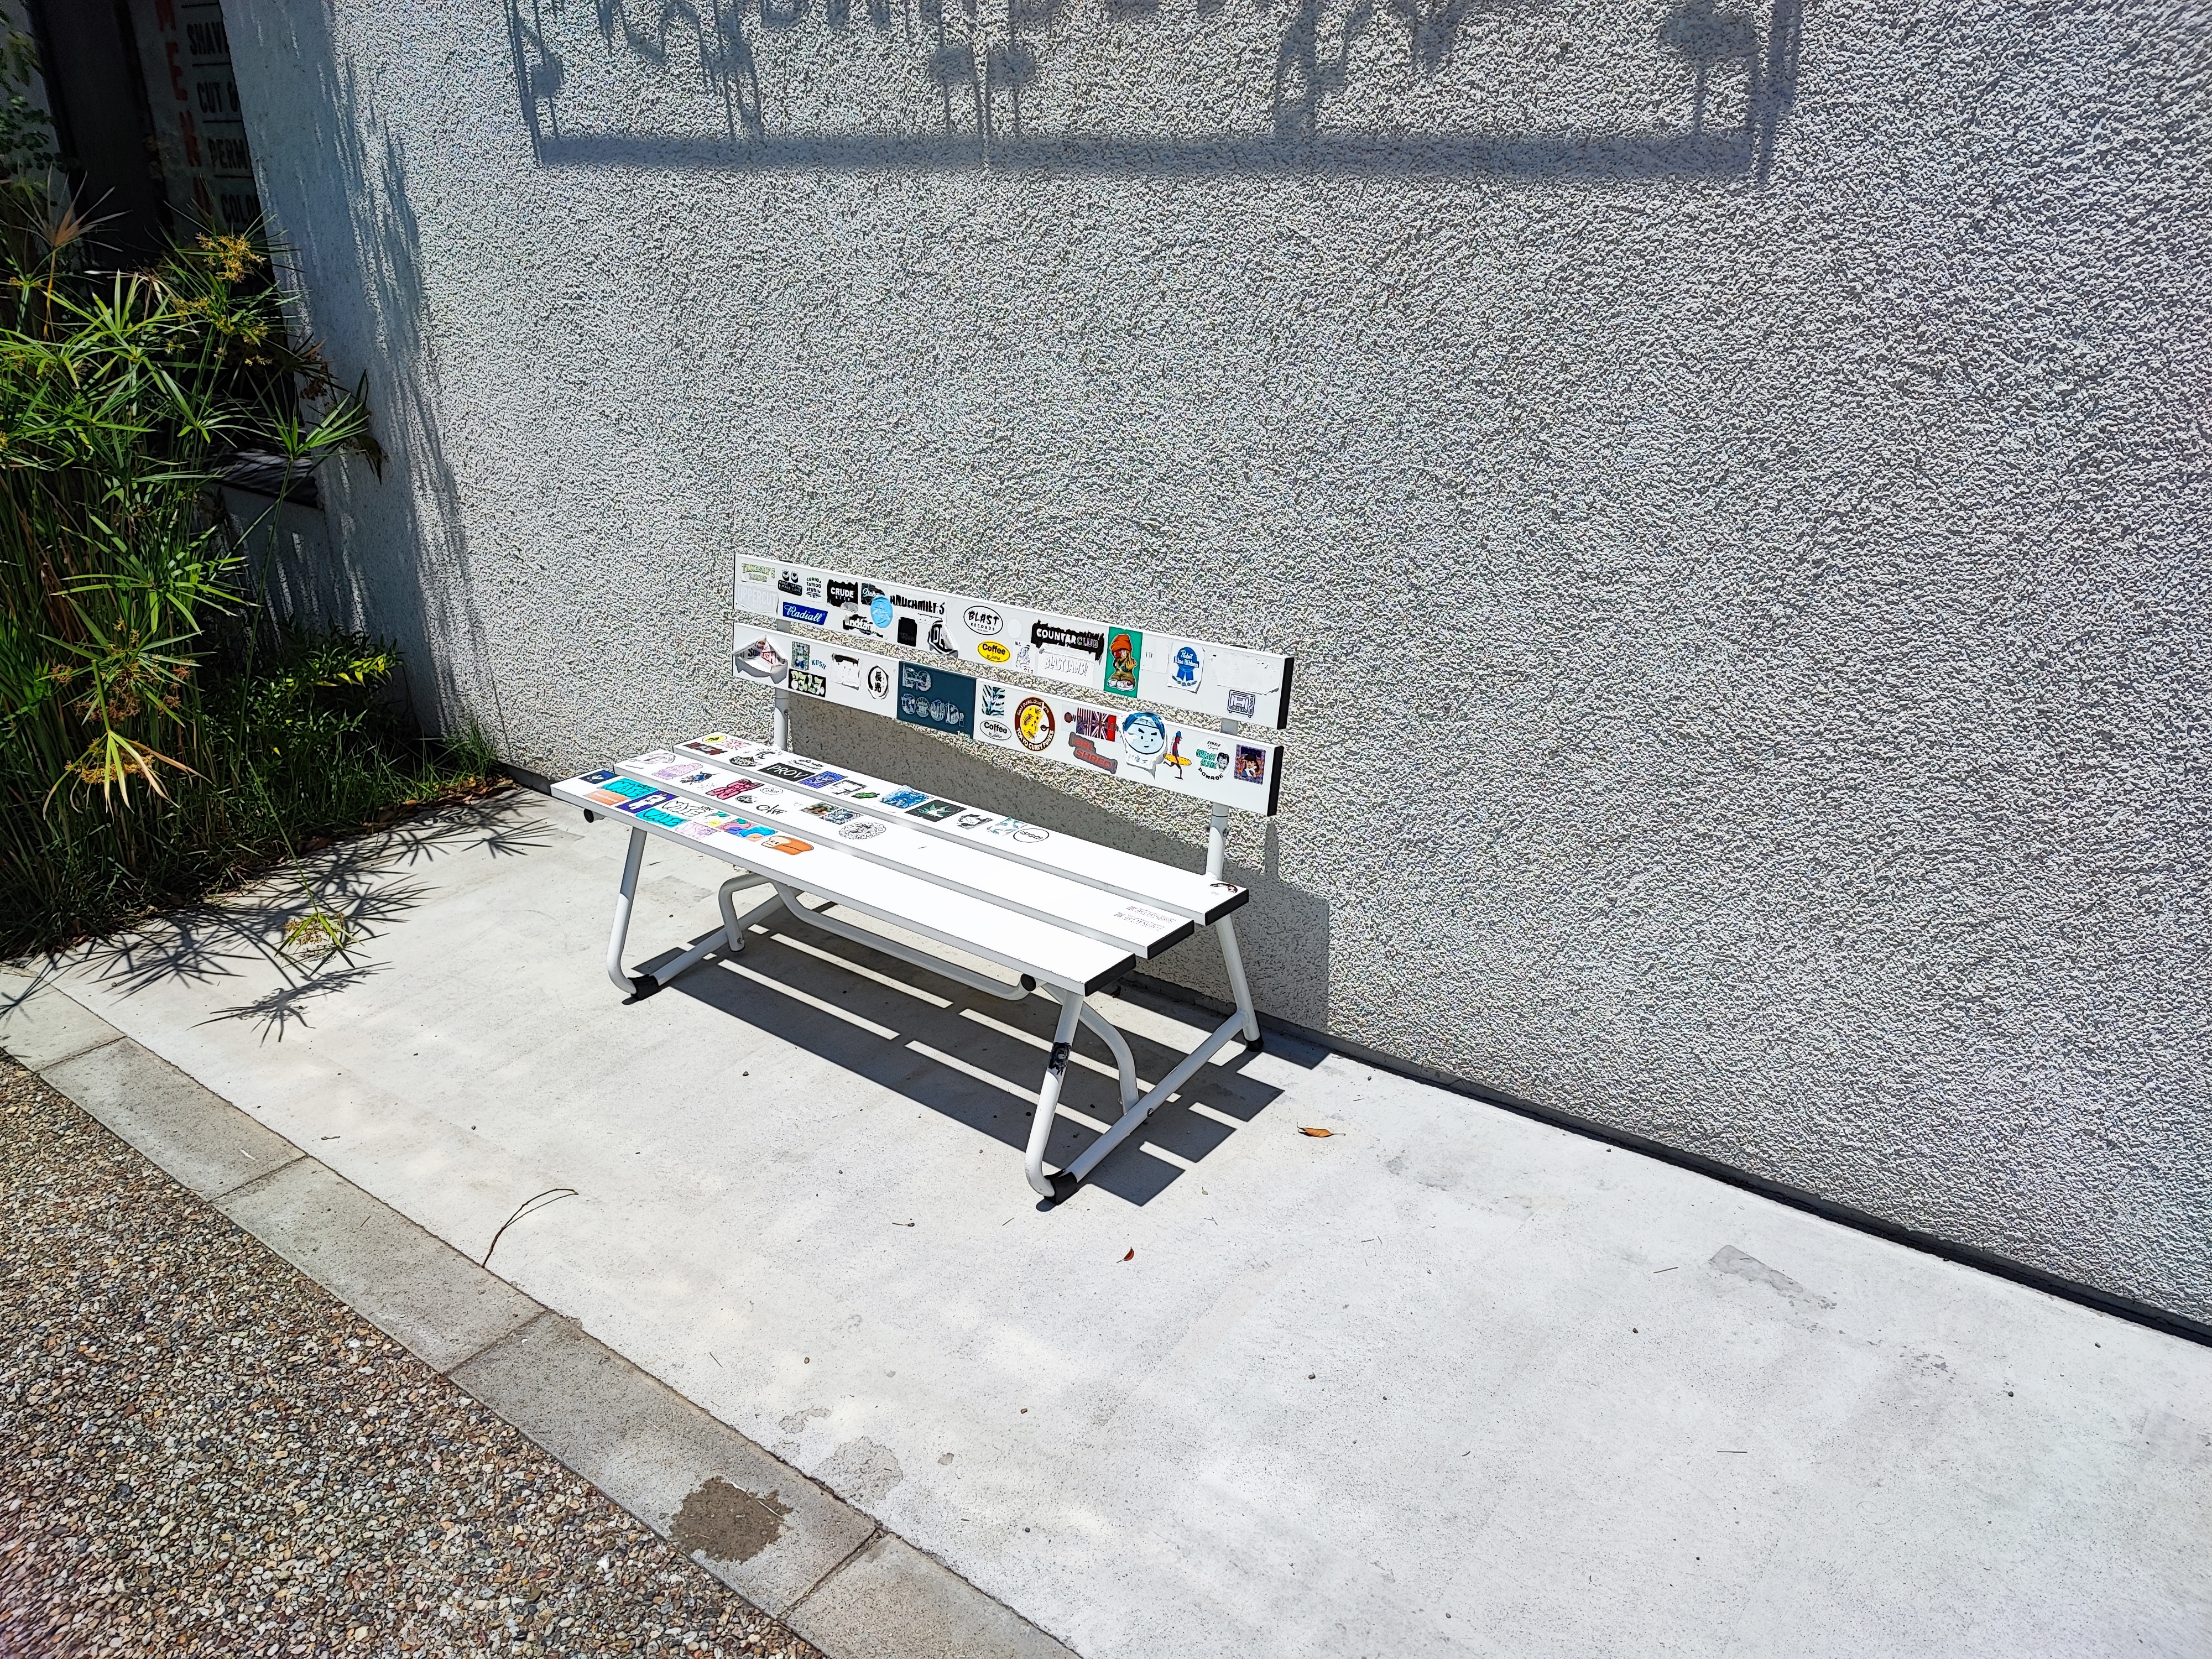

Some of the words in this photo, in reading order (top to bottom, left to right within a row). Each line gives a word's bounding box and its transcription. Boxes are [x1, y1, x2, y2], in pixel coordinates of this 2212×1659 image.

[197, 82, 223, 113] CUT
[208, 138, 248, 169] PERM
[737, 585, 778, 609] UPPERCUT
[831, 587, 855, 598] CRUDE
[784, 604, 822, 622] Radiall
[968, 610, 999, 625] BLAST
[971, 623, 995, 631] RECORDS
[983, 644, 1006, 655] Coffee
[1181, 650, 1193, 659] Pabst
[811, 659, 827, 670] KUSH
[984, 722, 1008, 734] Coffee
[1016, 726, 1028, 746] TOKYO
[1043, 730, 1054, 748] PUNKS
[1076, 749, 1112, 768] SHRED
[1196, 748, 1217, 761] GREASY
[767, 765, 807, 780] PROV
[1198, 767, 1224, 780] POMADE
